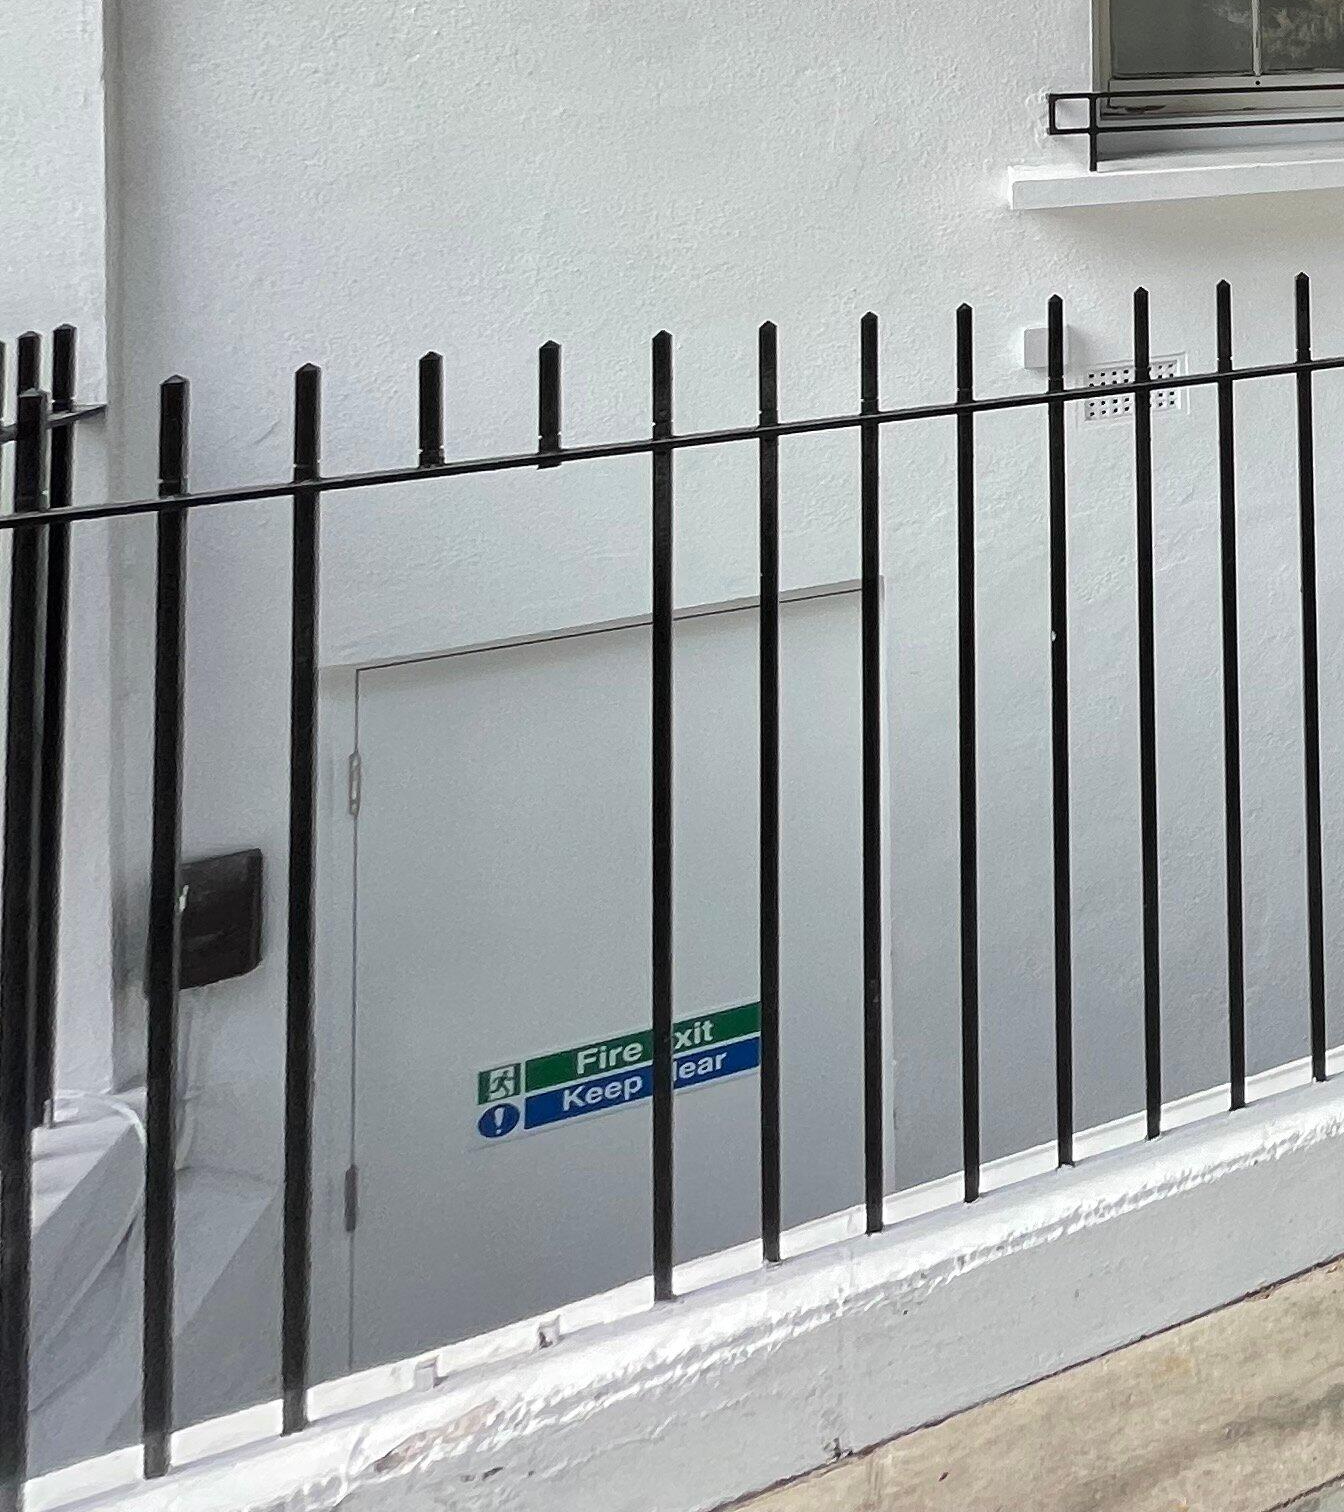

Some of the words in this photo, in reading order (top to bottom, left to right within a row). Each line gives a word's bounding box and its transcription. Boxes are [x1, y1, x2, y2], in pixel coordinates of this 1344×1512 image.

[576, 1041, 643, 1074] Fire
[664, 1019, 714, 1049] xit
[562, 1075, 643, 1111] Keep
[664, 1051, 728, 1082] lear
